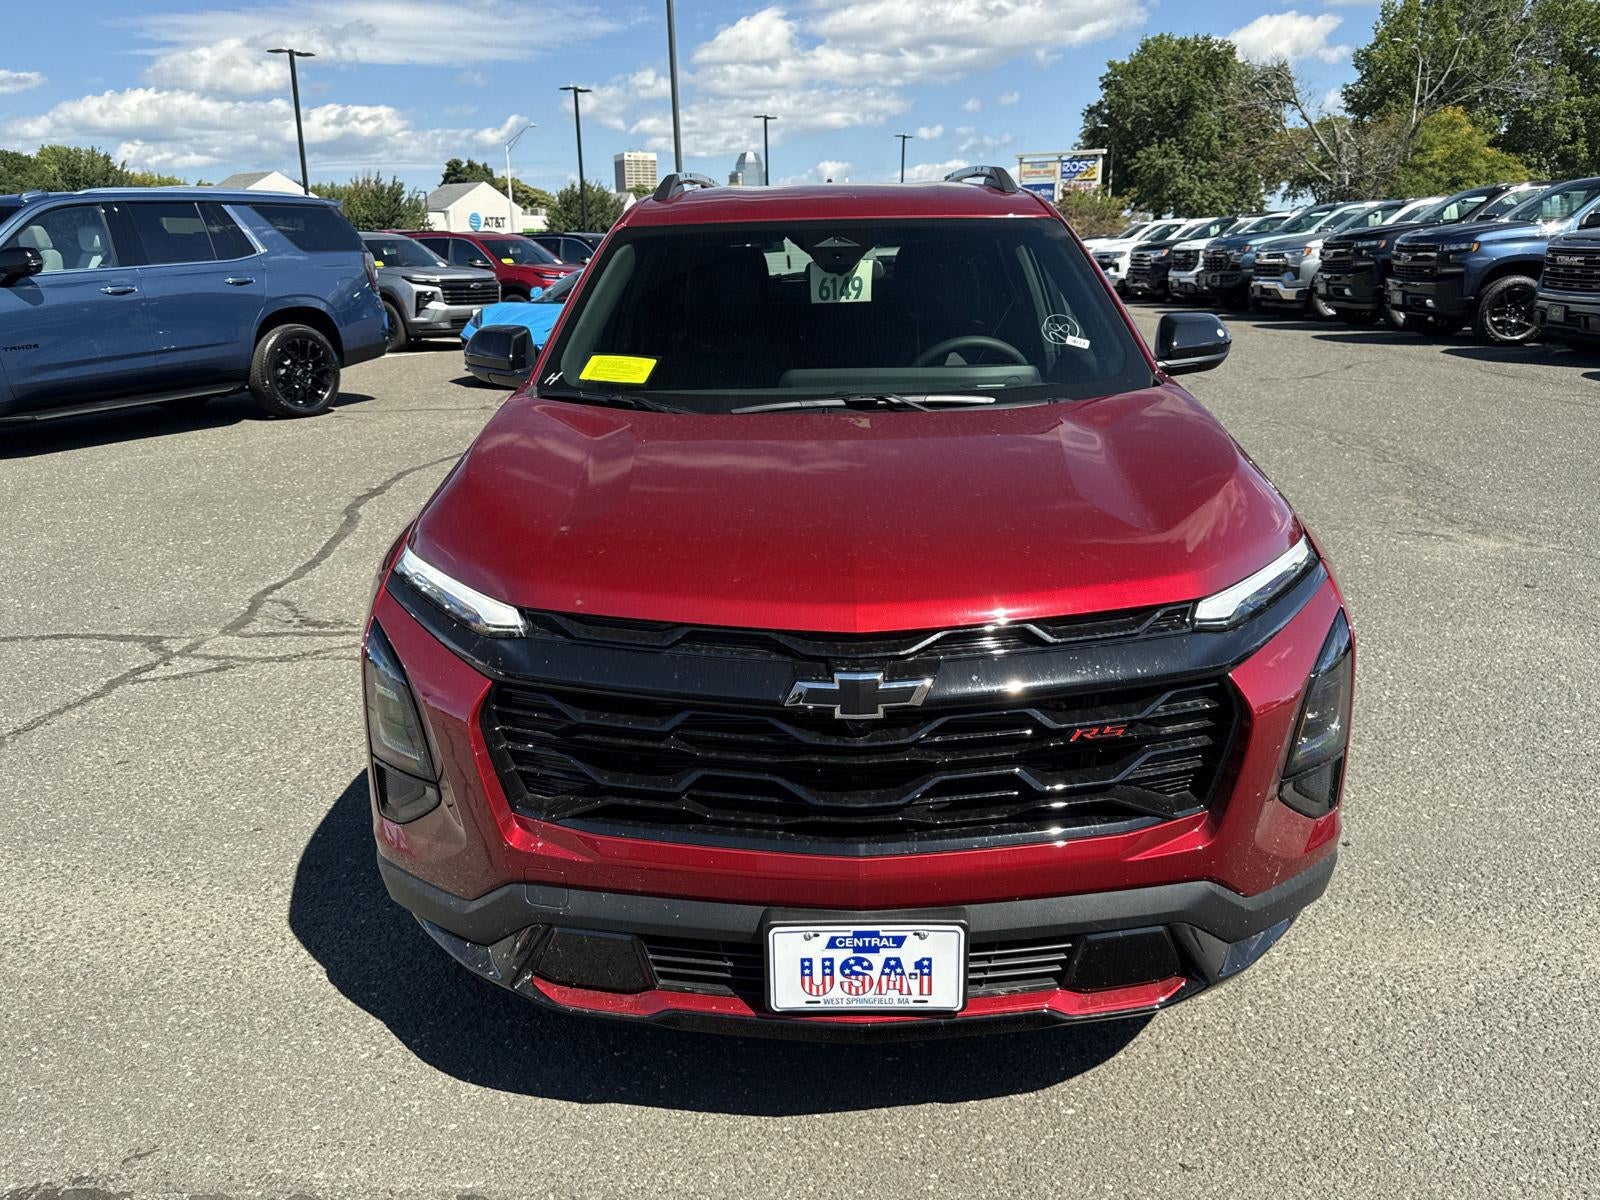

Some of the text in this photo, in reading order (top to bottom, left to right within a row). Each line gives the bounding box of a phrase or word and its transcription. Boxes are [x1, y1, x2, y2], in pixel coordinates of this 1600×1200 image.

[483, 216, 506, 228] AT&T
[817, 276, 863, 301] 6149
[2, 343, 40, 352] TAHOE
[1070, 724, 1128, 742] RS
[835, 937, 898, 947] CENTRAL
[846, 997, 896, 1005] SPRINGFIELD,
[897, 997, 910, 1005] MA
